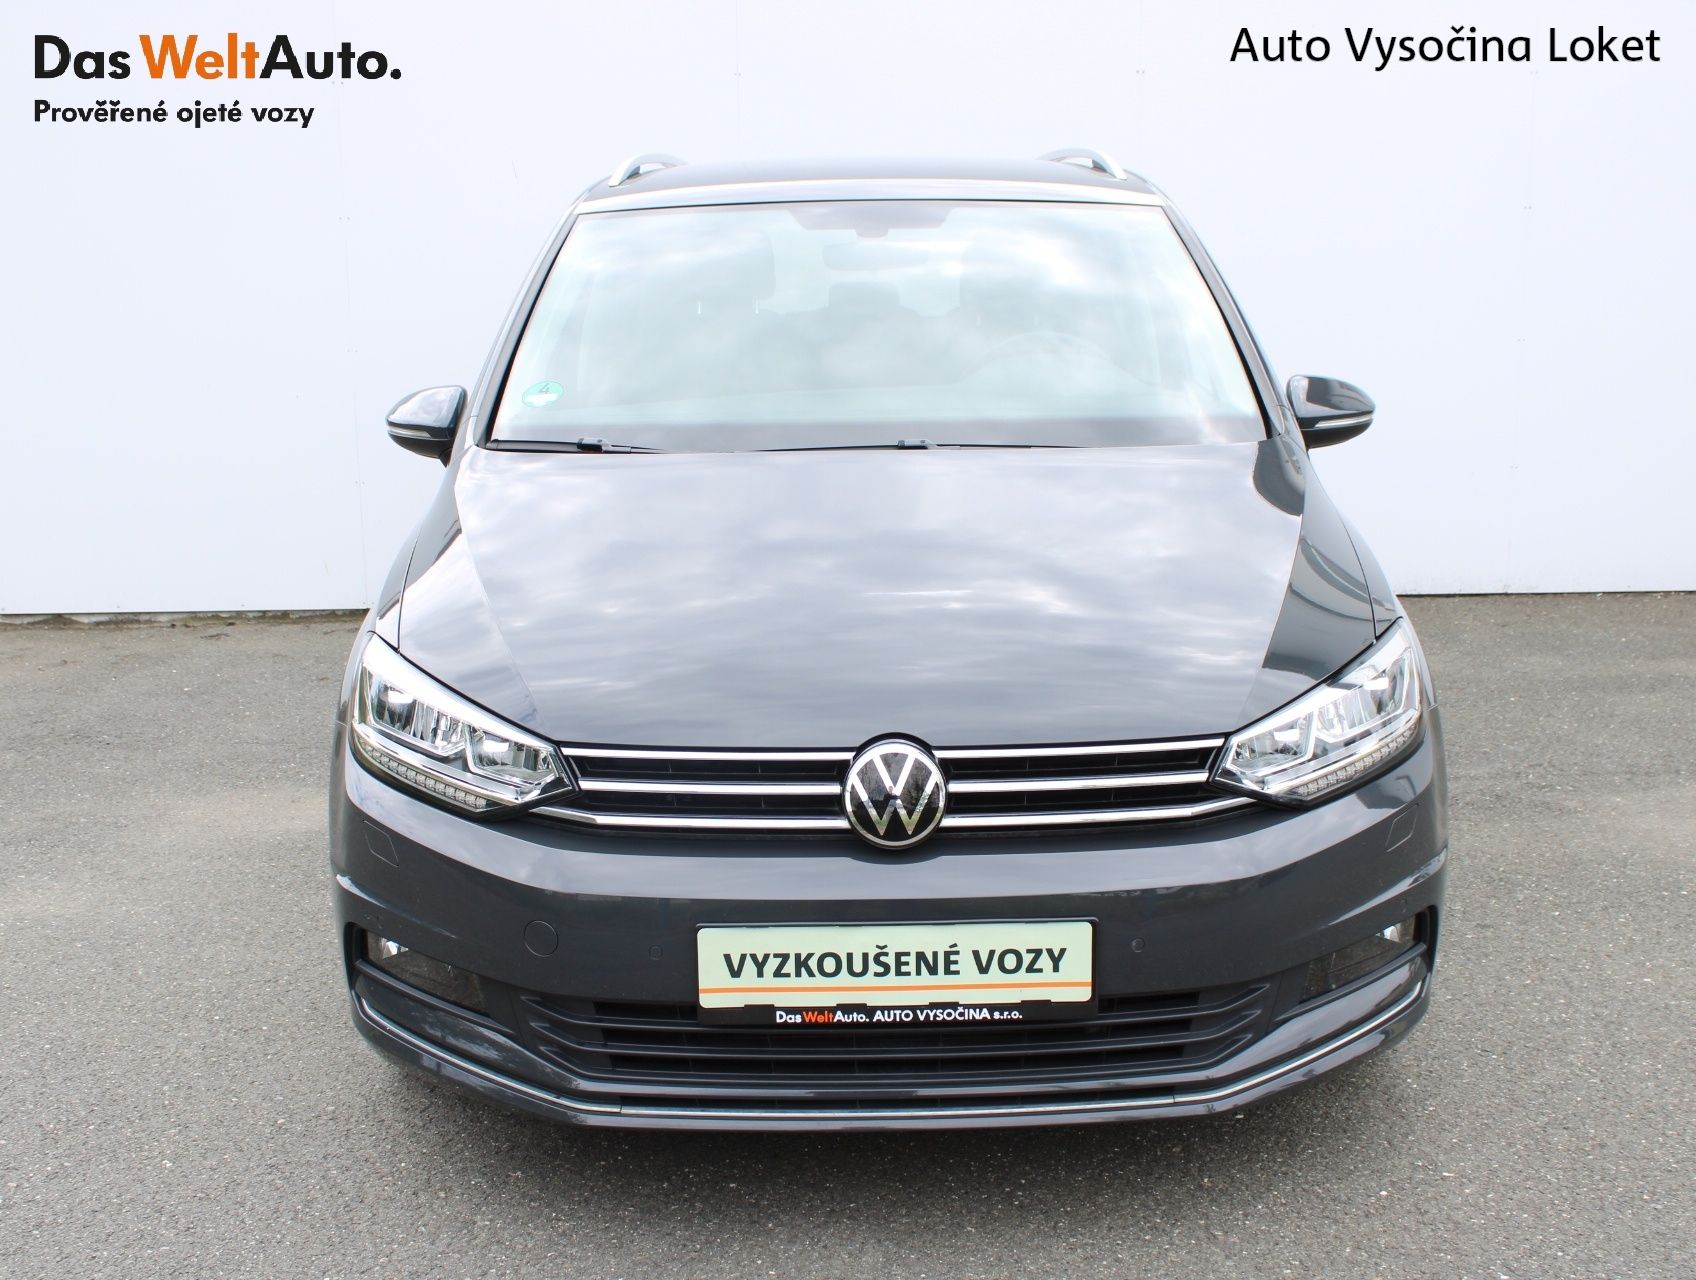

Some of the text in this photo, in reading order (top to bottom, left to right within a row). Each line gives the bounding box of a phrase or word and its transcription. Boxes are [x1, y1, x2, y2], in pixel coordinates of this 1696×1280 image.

[722, 943, 1068, 979] VYZKOUŠENÉ VOZY
[775, 1010, 802, 1024] Das
[872, 1009, 914, 1023] AUTO
[916, 1006, 991, 1022] VYSOČINA
[992, 1010, 1023, 1021] s.r.o.
